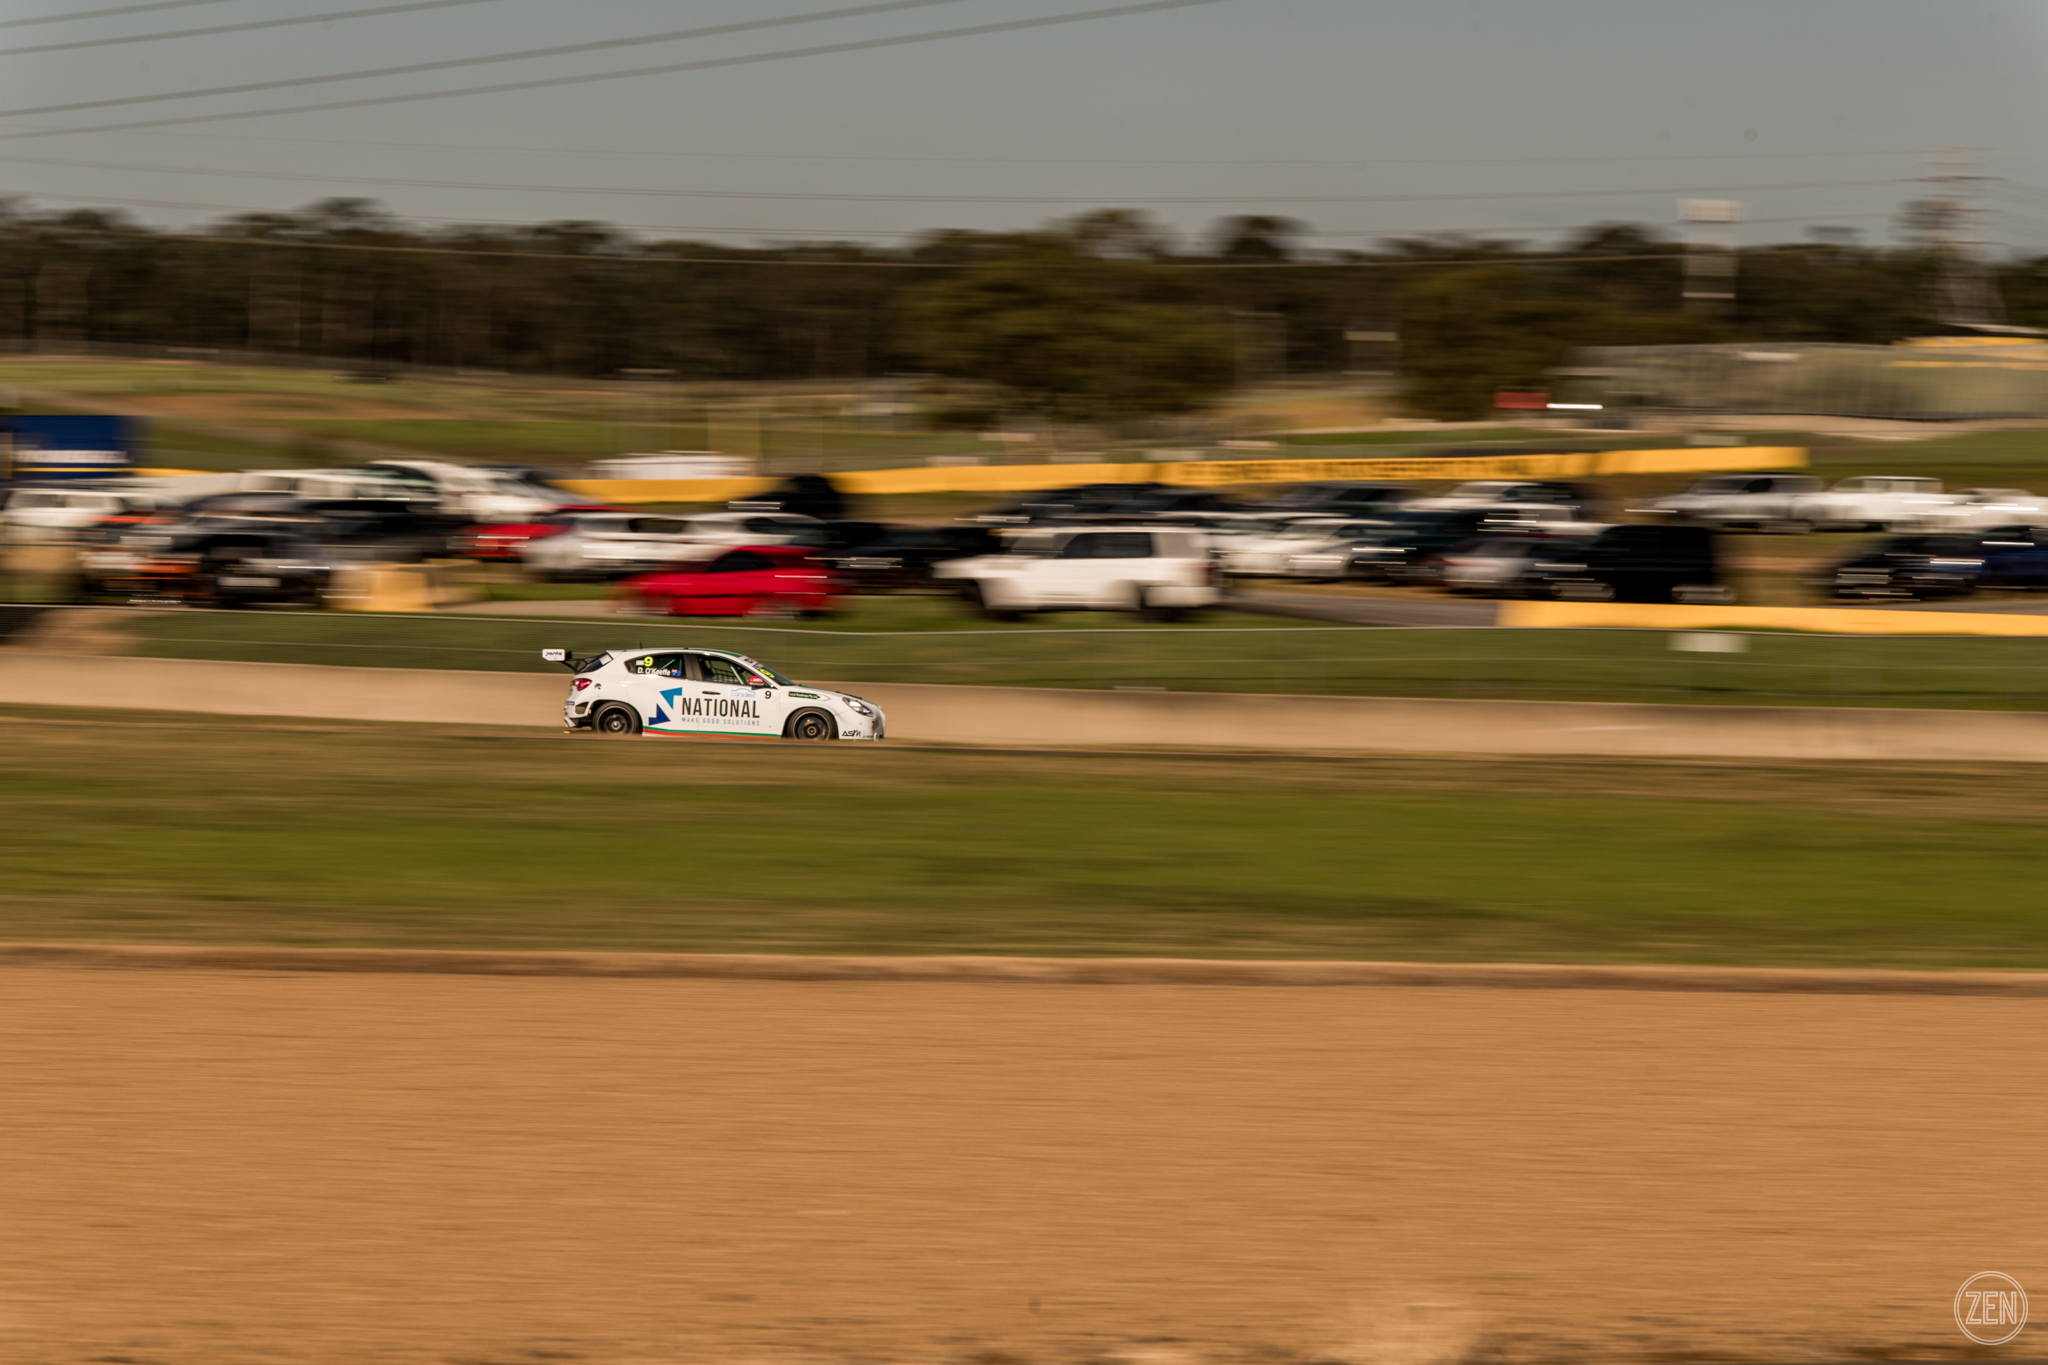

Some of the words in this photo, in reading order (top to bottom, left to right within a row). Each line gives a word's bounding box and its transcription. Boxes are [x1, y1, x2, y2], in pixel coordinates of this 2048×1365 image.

[644, 656, 654, 667] 9
[765, 690, 772, 700] 9
[682, 697, 760, 719] NATIONAL
